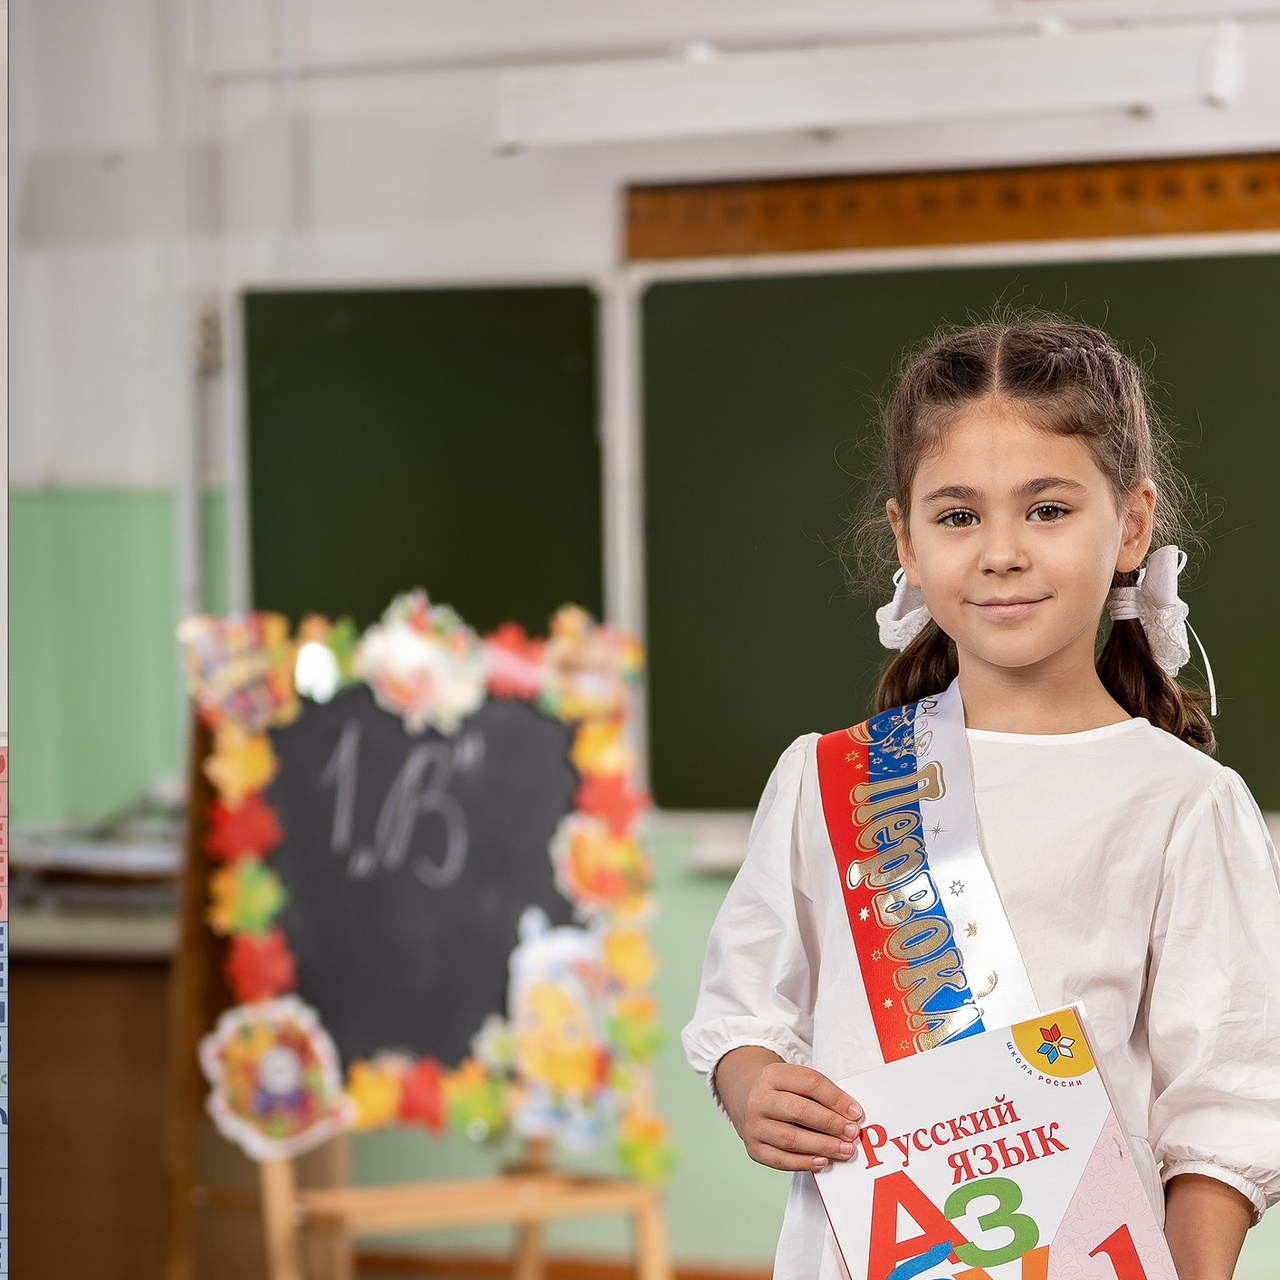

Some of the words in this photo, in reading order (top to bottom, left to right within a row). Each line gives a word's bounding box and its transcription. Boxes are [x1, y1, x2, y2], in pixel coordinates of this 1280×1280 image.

[1006, 1041, 1033, 1076] ШКОЛА
[1038, 1075, 1082, 1088] РОССИИ
[860, 1094, 1021, 1170] Русский
